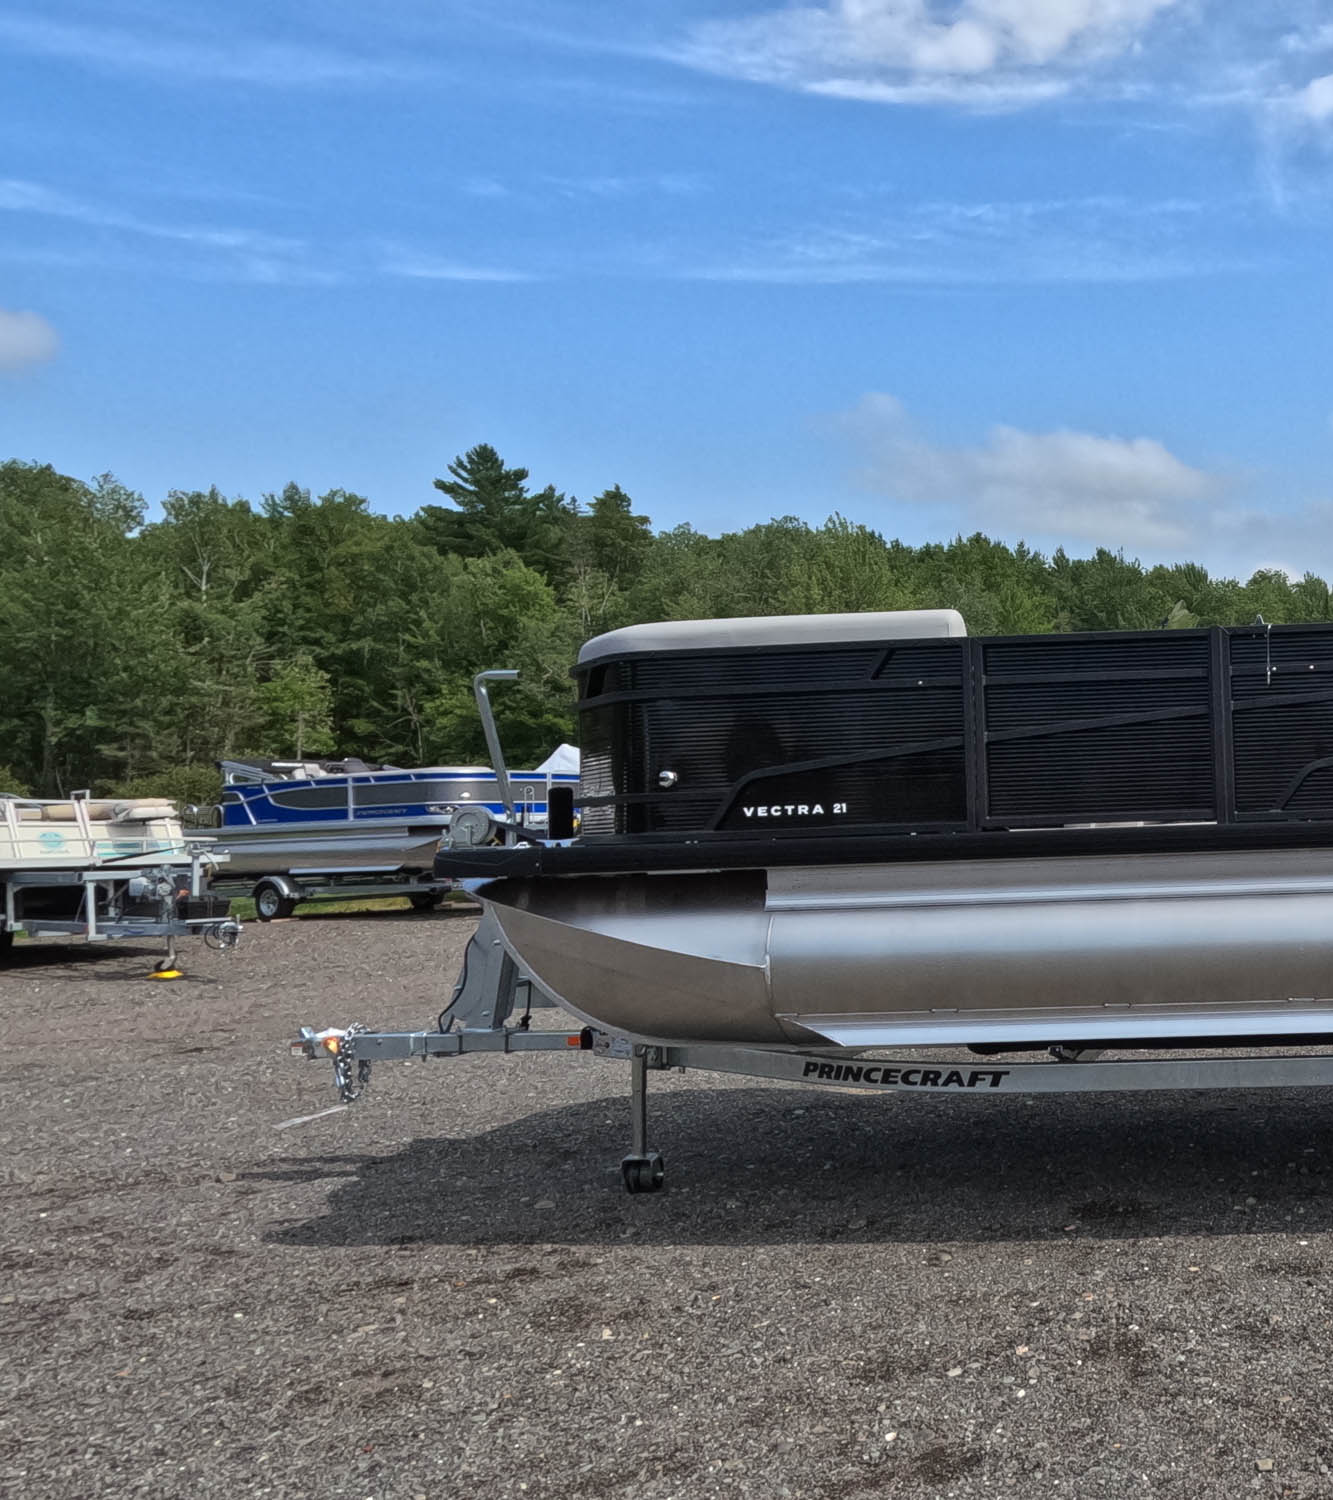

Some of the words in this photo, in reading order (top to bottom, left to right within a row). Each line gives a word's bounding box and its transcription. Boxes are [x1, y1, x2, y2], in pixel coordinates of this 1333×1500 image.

[743, 804, 825, 817] VECTRA
[832, 802, 847, 814] 21
[802, 1061, 1010, 1088] PRINCECRAFT
